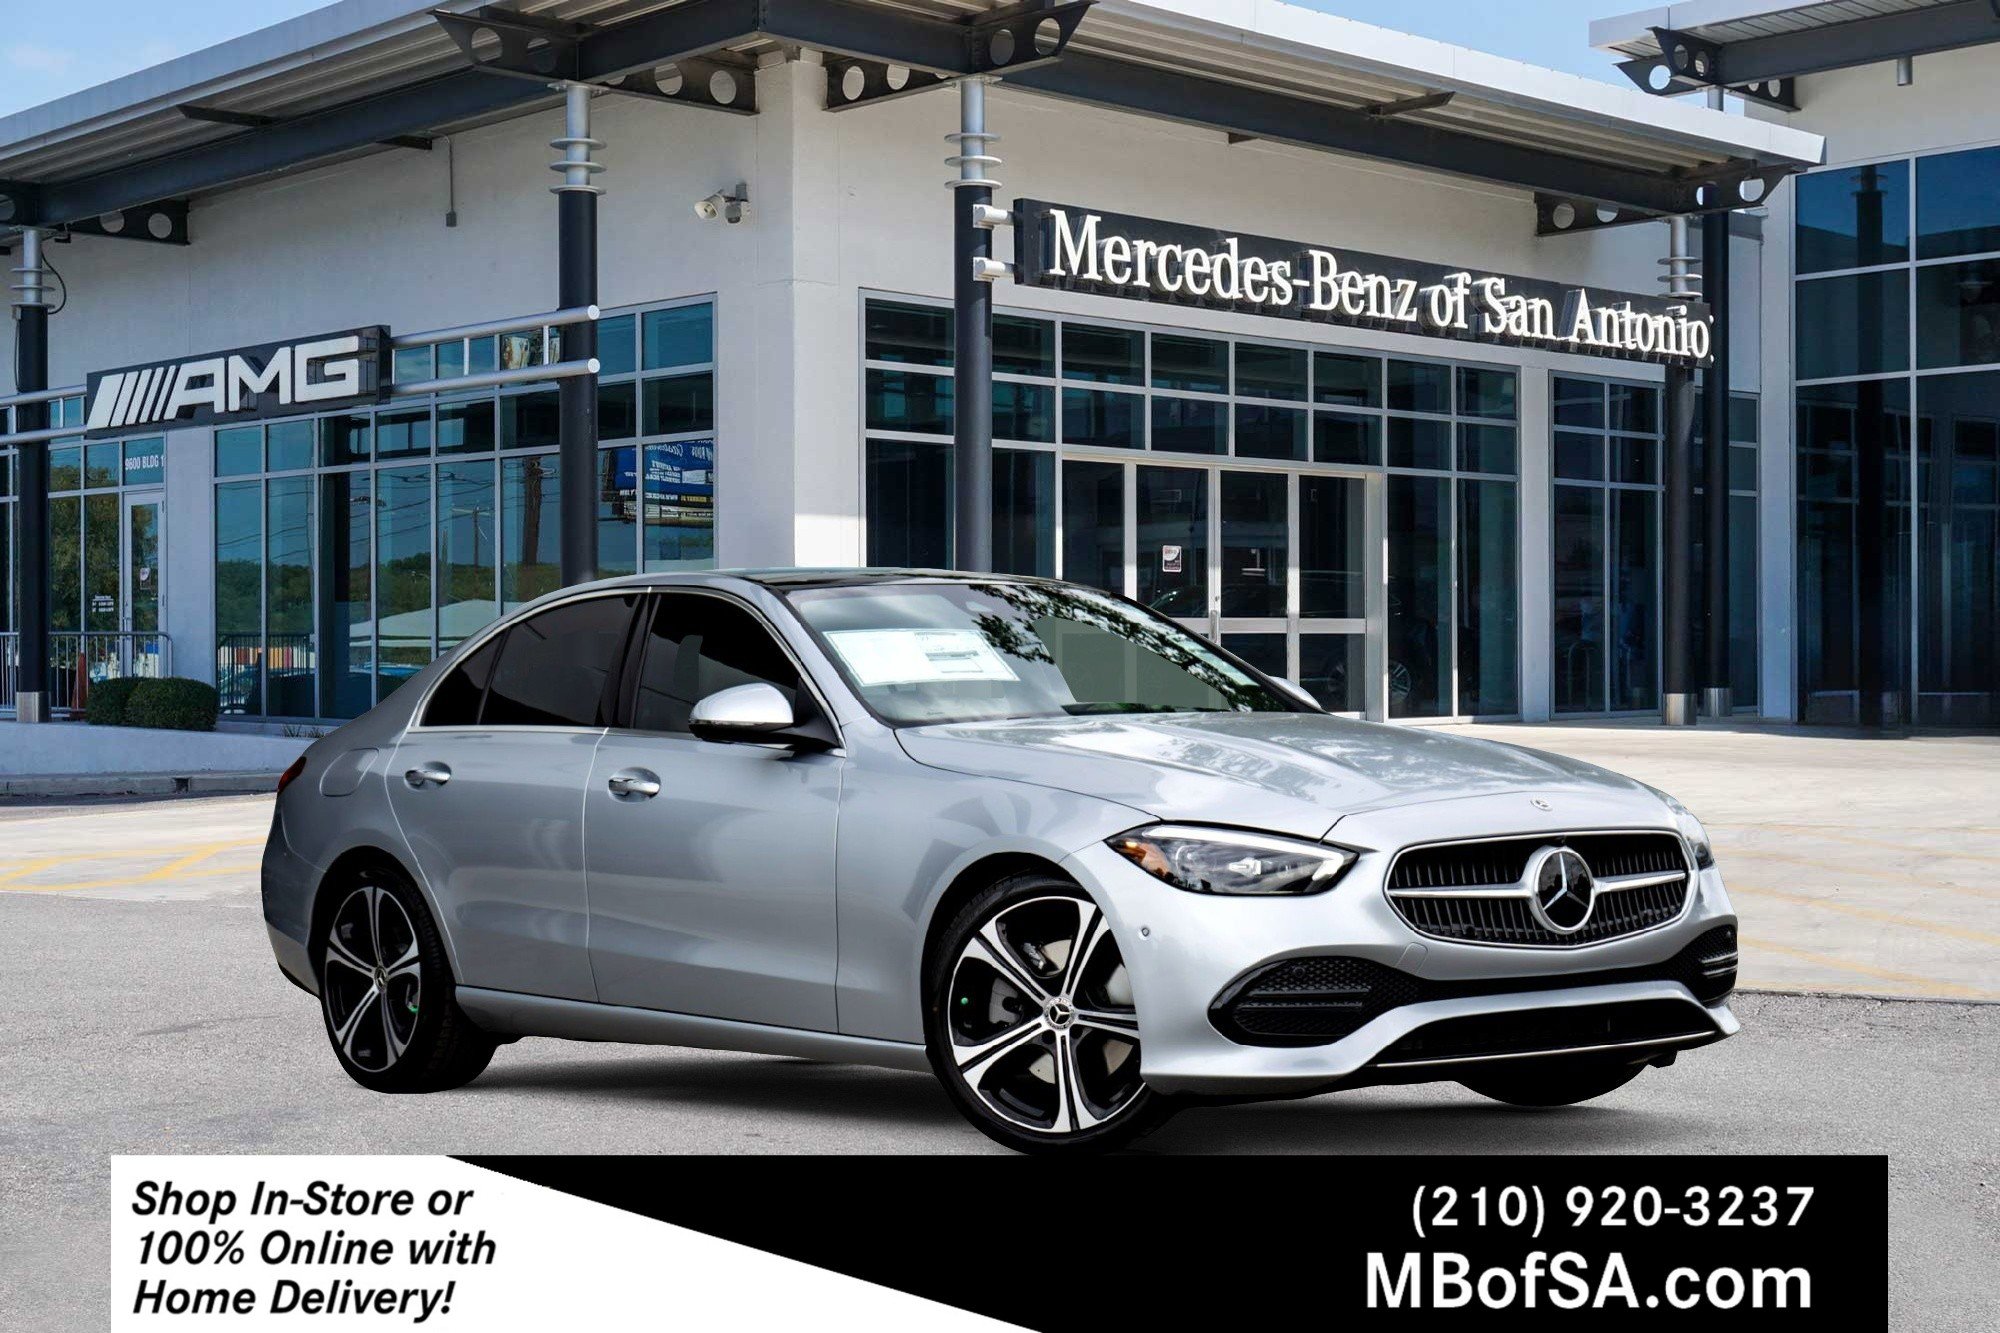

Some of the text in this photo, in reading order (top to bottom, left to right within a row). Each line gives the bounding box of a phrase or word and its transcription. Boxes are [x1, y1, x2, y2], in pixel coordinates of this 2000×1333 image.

[1049, 208, 1709, 358] Mercedes-Benz of San Antonio
[142, 454, 159, 469] BLDG
